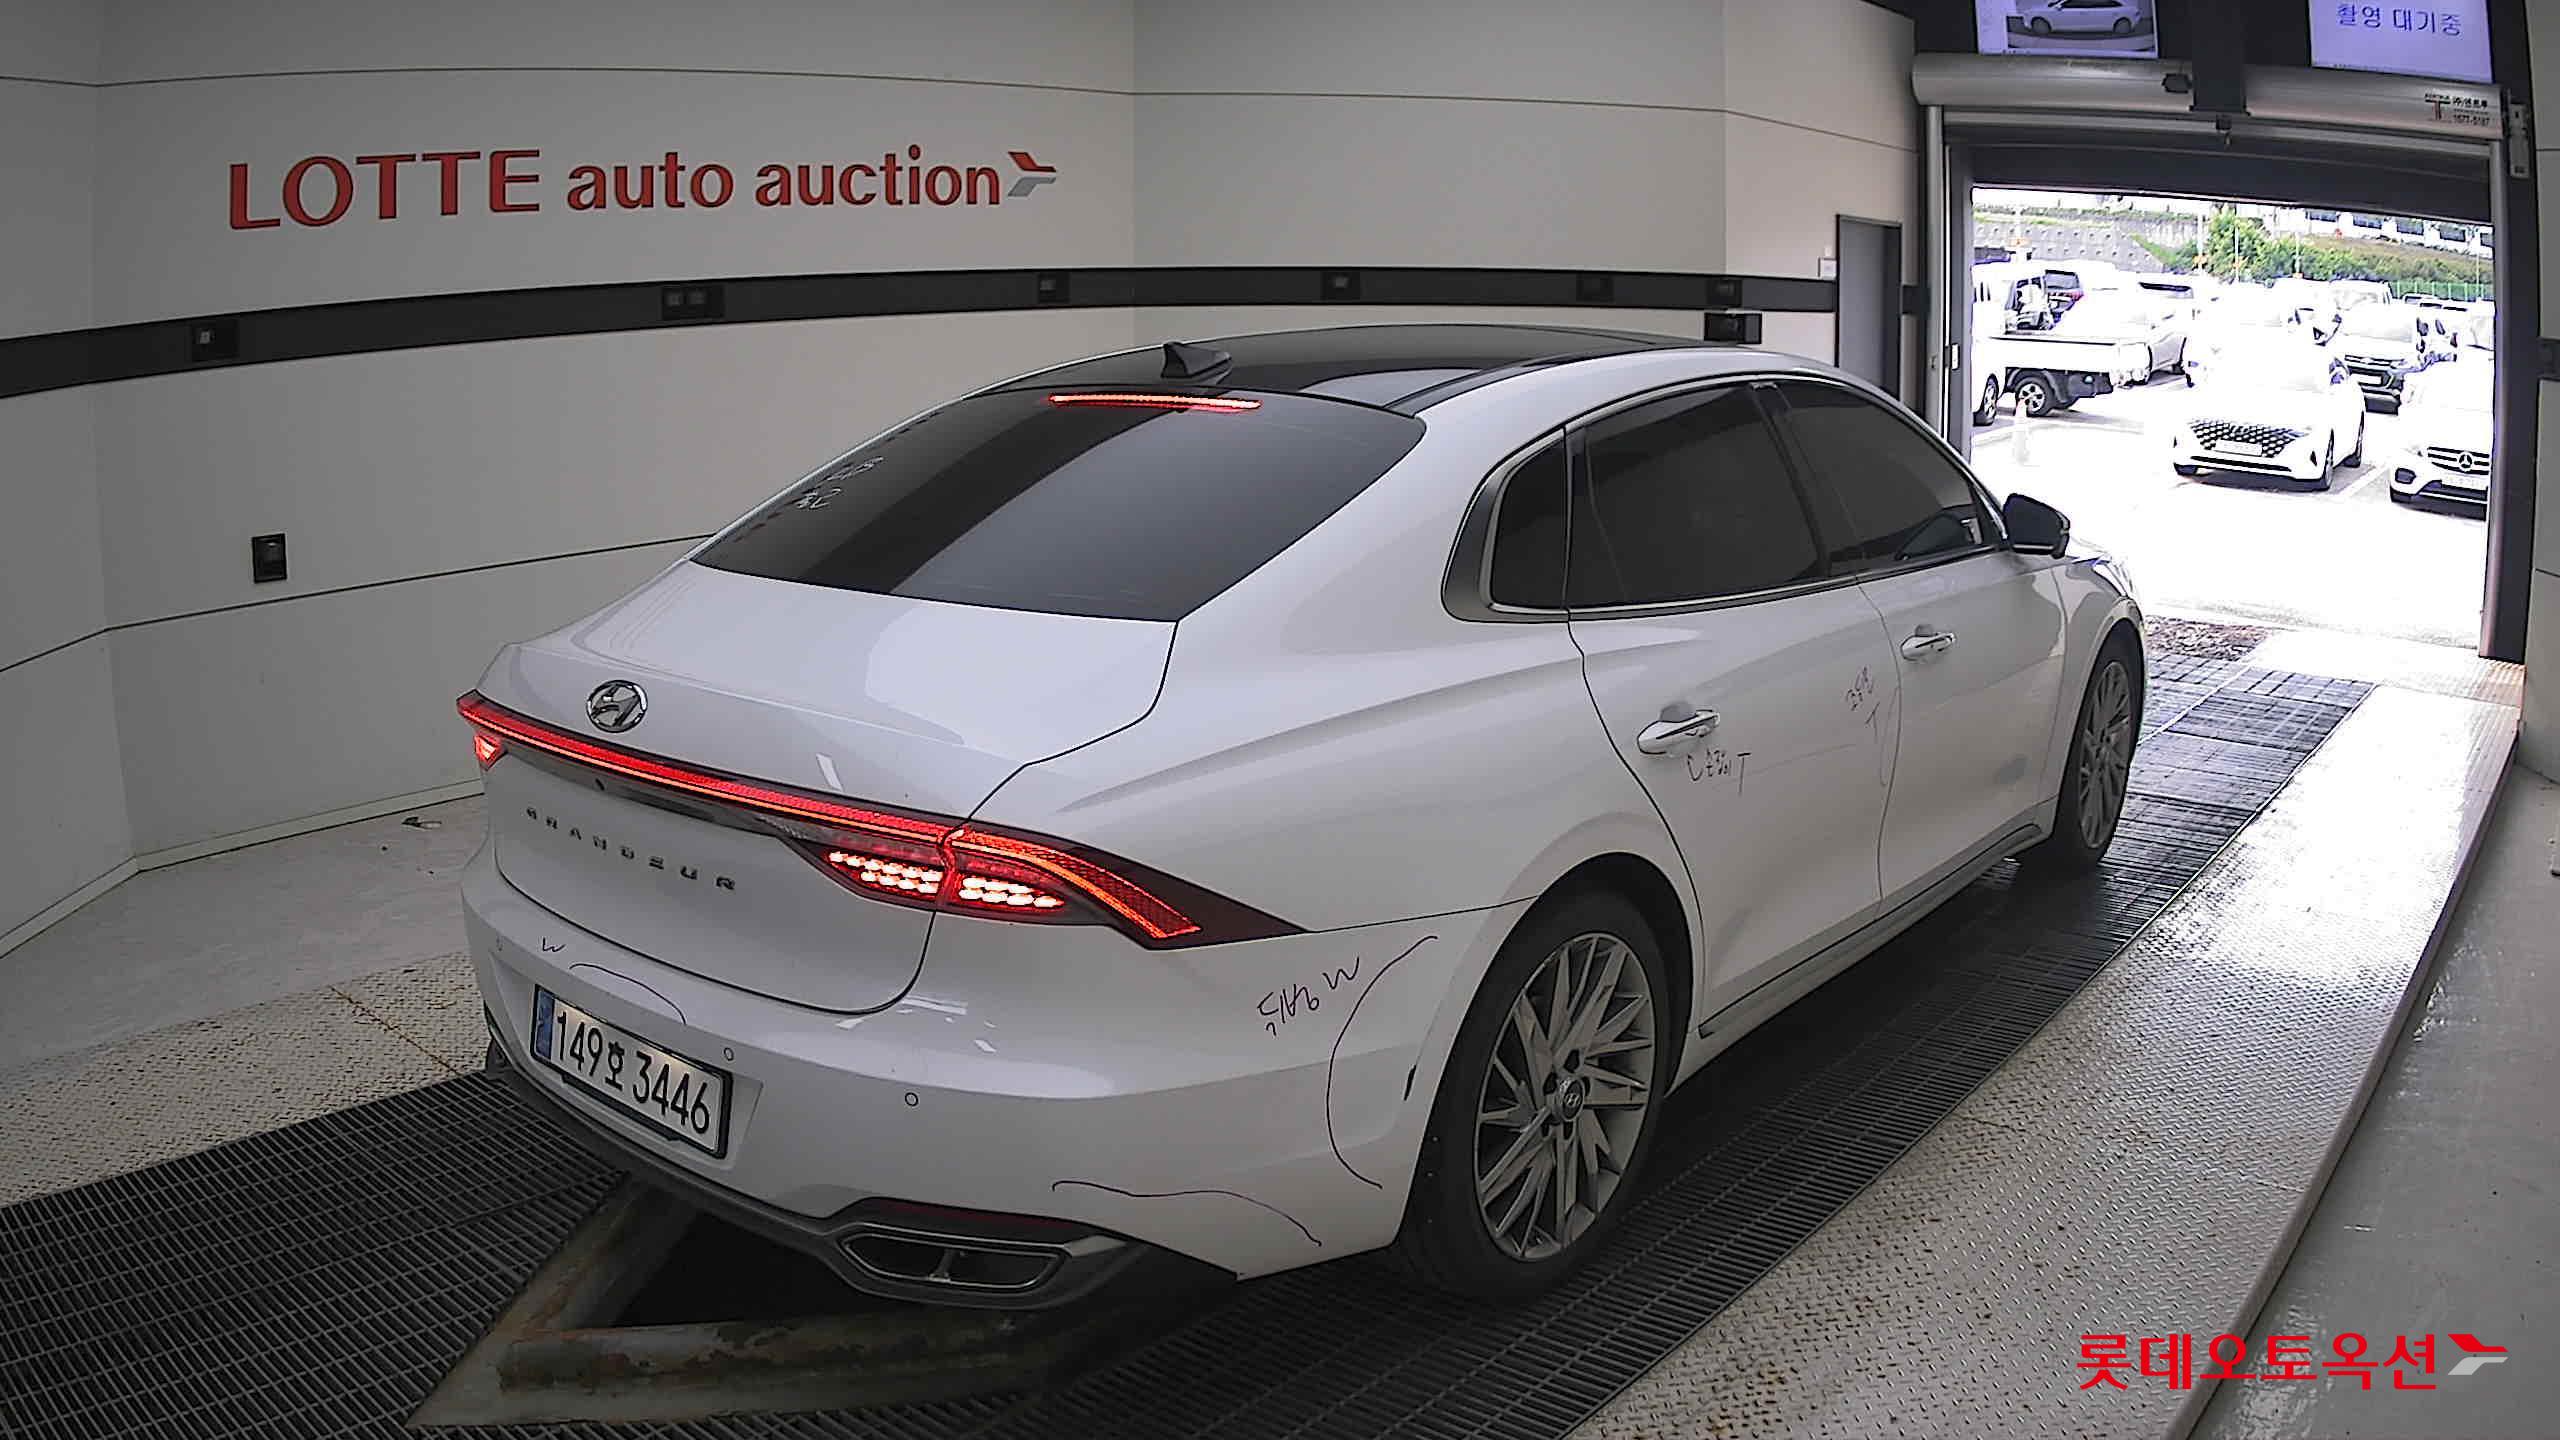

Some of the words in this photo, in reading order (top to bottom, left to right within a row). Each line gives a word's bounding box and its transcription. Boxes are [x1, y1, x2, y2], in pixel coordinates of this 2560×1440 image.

[2393, 9, 2462, 37] 대기중
[228, 149, 541, 231] LOTTE
[566, 150, 735, 211] auto
[754, 144, 1002, 208] auction
[526, 807, 735, 890] GRANDEUR
[555, 1011, 625, 1091] 149호
[632, 1050, 710, 1135] 3446
